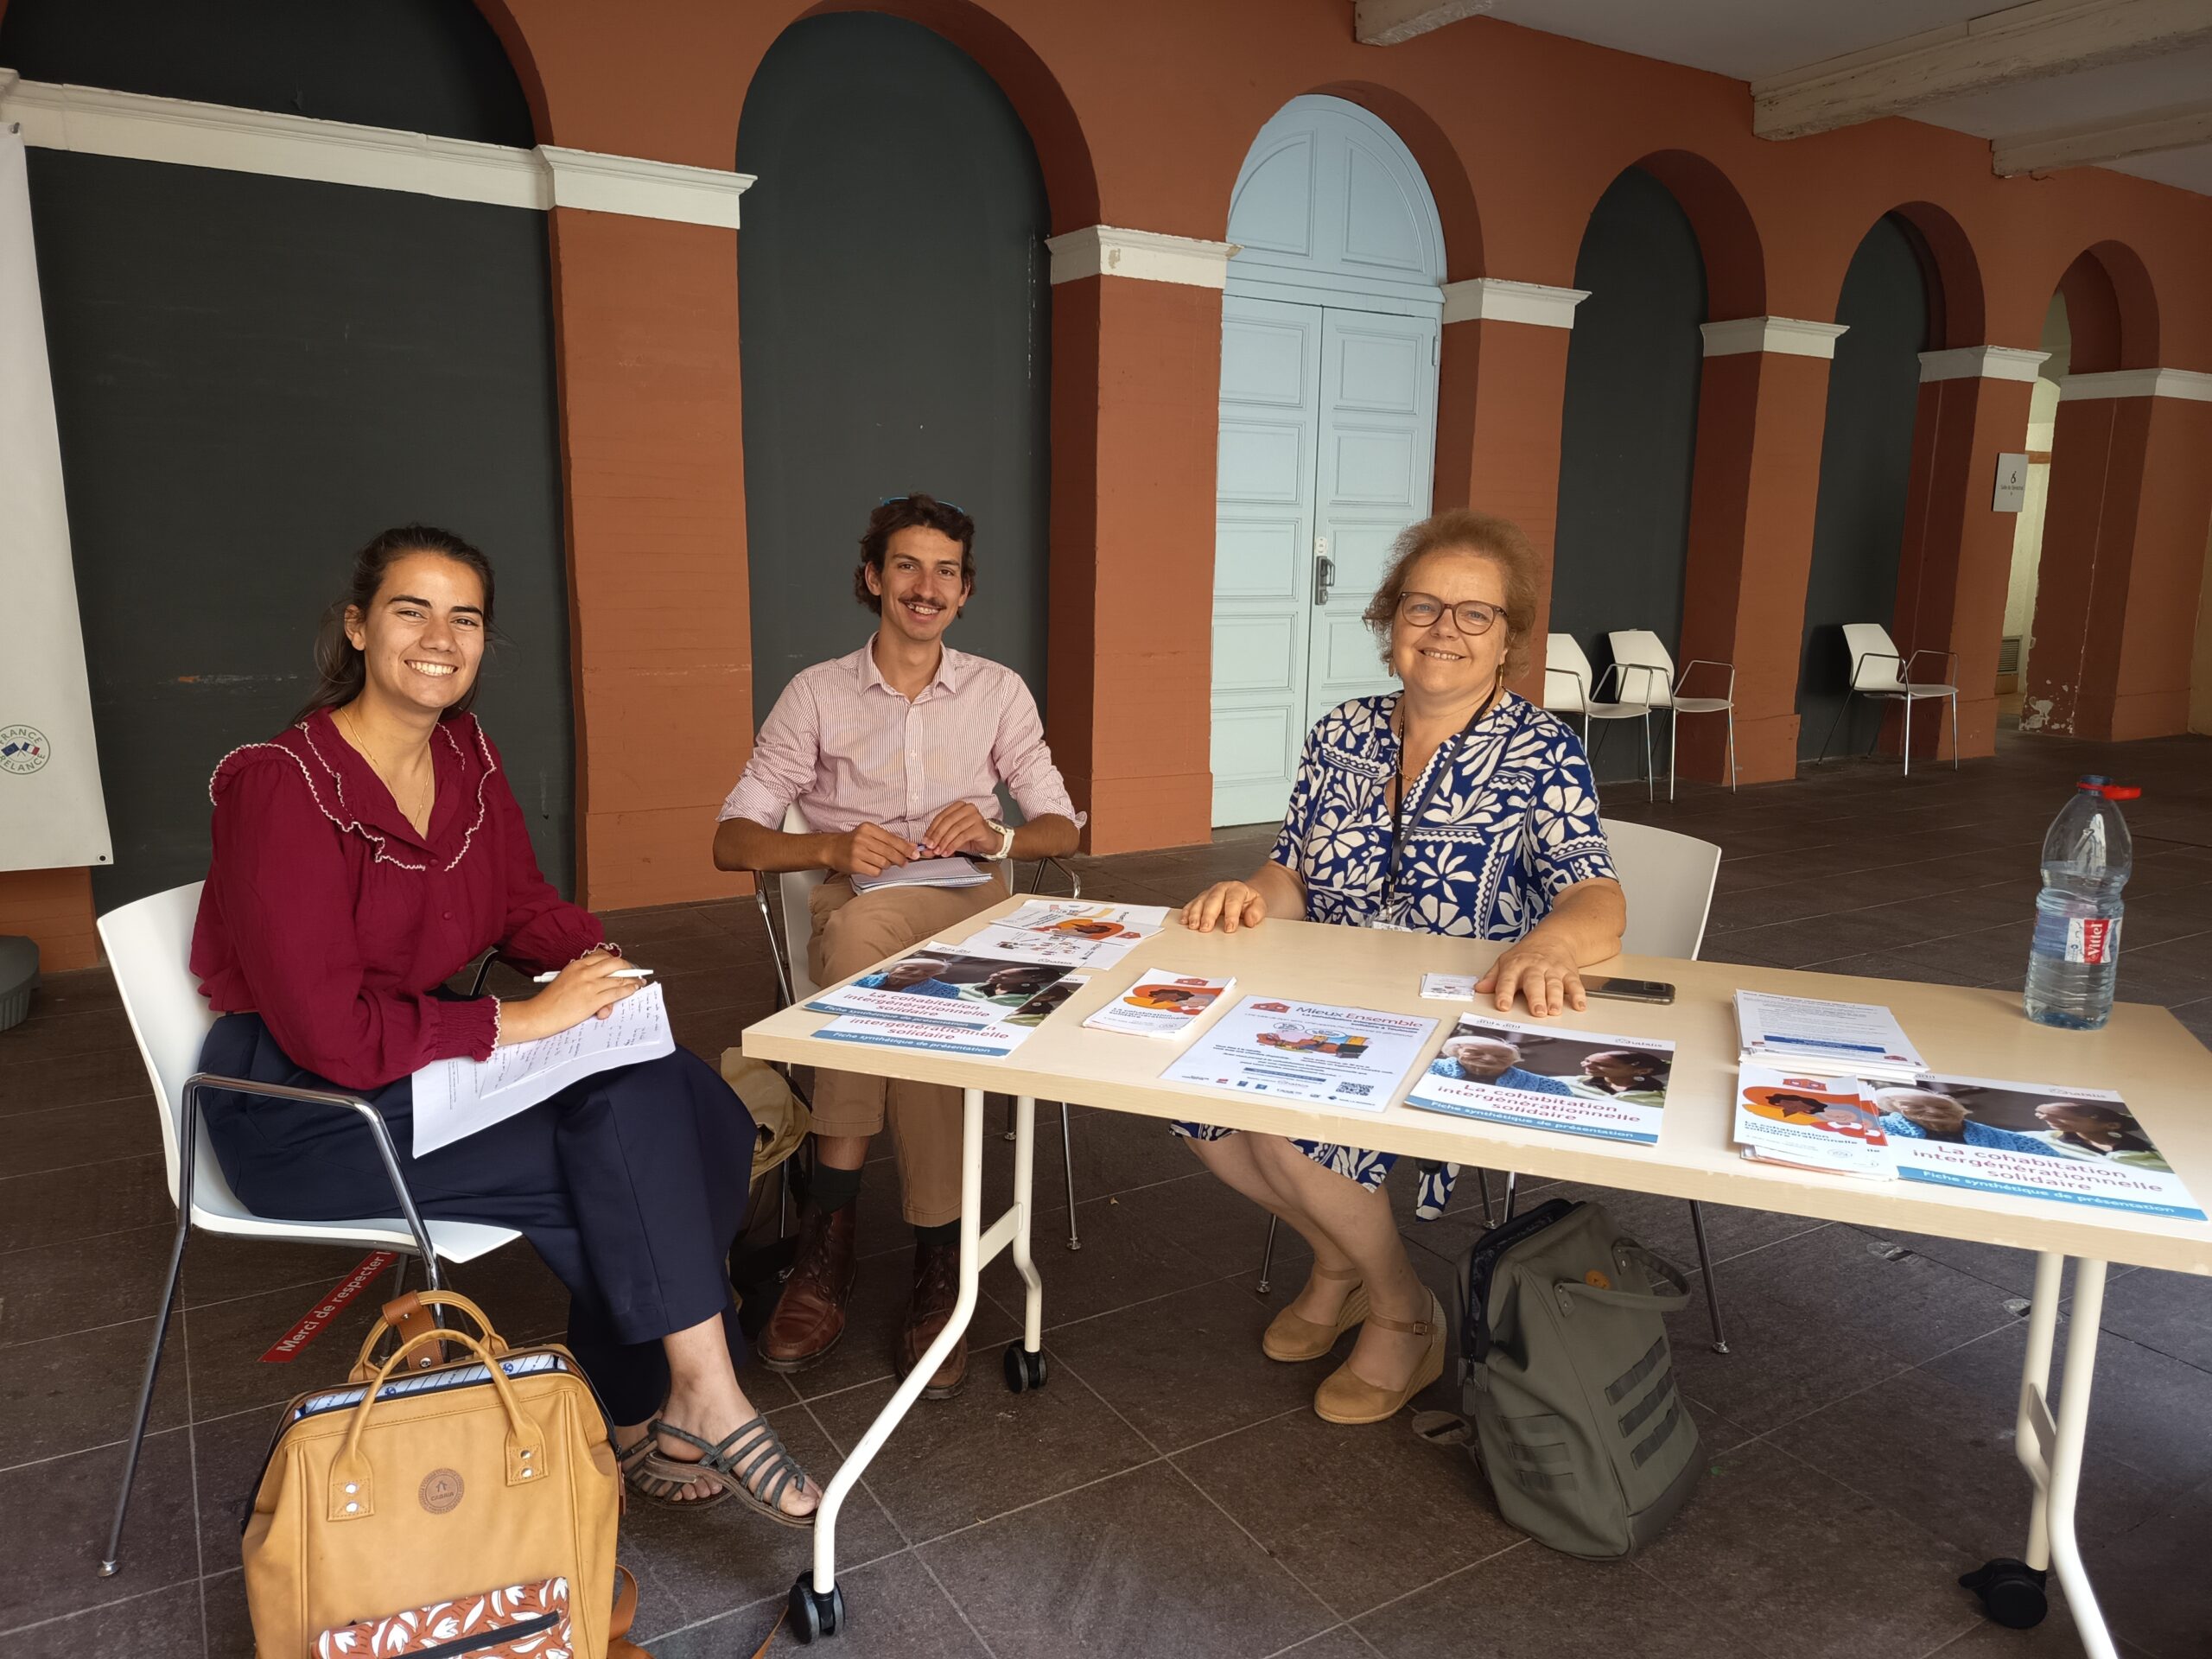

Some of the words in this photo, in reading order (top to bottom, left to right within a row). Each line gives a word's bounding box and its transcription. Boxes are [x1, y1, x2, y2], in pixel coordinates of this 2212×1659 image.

[0, 728, 42, 744] FRANCE
[0, 753, 45, 772] RELANCE
[2088, 923, 2103, 956] Vittel
[843, 994, 990, 1018] intergénérationnelle
[876, 1005, 938, 1017] solidaire
[891, 994, 981, 1010] cohabitation
[1295, 1006, 1344, 1018] Mieux
[1345, 1012, 1422, 1027] Ensemble
[860, 1033, 914, 1046] synthétique
[929, 1041, 991, 1053] présentation
[887, 1027, 955, 1040] solidaire
[1437, 1085, 1641, 1122] intergénérationnelle
[1464, 1084, 1485, 1093] La
[1493, 1087, 1618, 1112] cohabitation
[1431, 1101, 1461, 1111] Fiche
[1465, 1107, 1533, 1123] synthétique
[1554, 1122, 1634, 1138] présentation
[1492, 1103, 1577, 1121] solidaire
[1913, 1149, 2163, 1192] intergénérationnelle
[1938, 1145, 1964, 1156] La
[1974, 1148, 2127, 1179] cohabitation
[1986, 1168, 2092, 1191] solidaire
[1922, 1170, 1961, 1183] Fiche
[1964, 1177, 2050, 1198] synthétique
[2052, 1190, 2072, 1199] de
[2076, 1196, 2175, 1214] présentation
[276, 1320, 321, 1352] Merci
[313, 1305, 336, 1319] de
[332, 1256, 385, 1303] respecter
